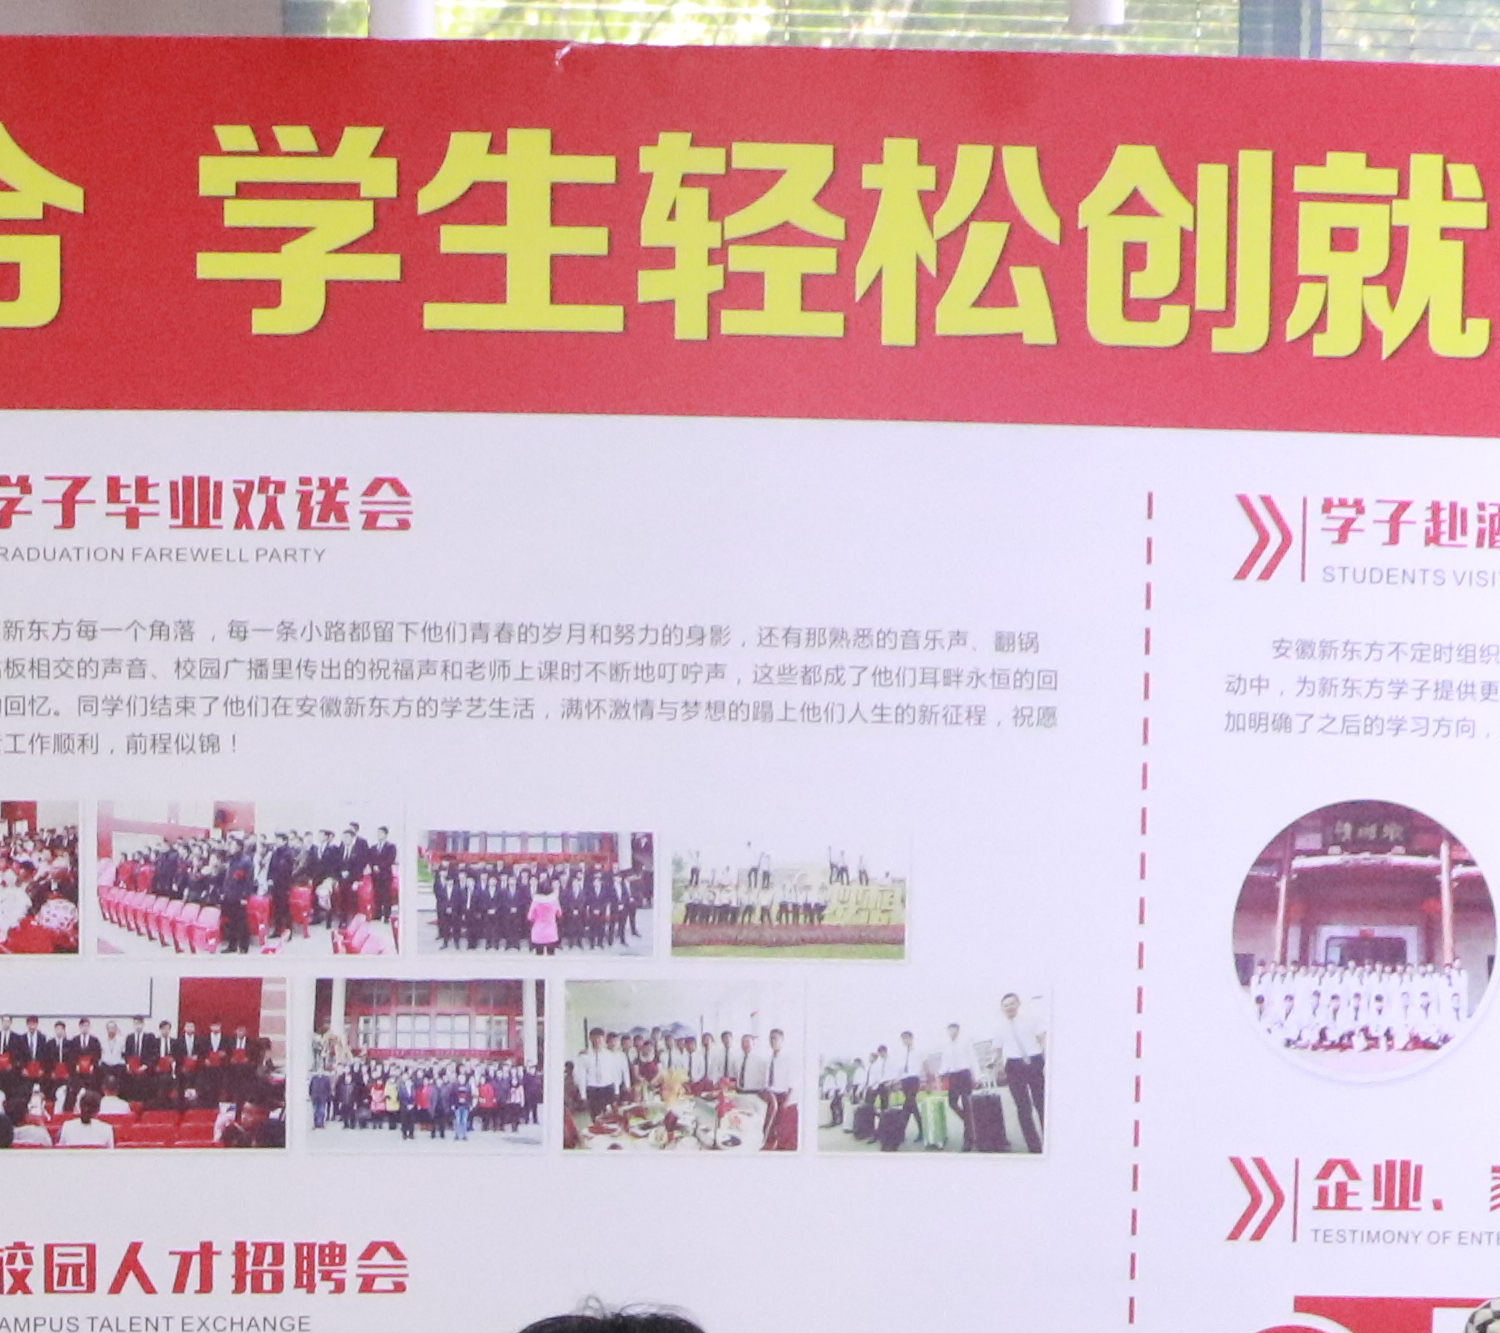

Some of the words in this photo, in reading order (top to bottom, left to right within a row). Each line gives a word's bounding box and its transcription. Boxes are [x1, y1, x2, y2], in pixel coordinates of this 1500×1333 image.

[132, 547, 248, 562] FAREWELL
[256, 548, 325, 562] PARTY
[1323, 566, 1445, 586] STUDENTS
[1312, 1229, 1421, 1244] TESTIMONY
[1427, 1230, 1452, 1245] OF
[87, 1316, 173, 1332] TALENT
[181, 1316, 310, 1332] EXCHANGE
